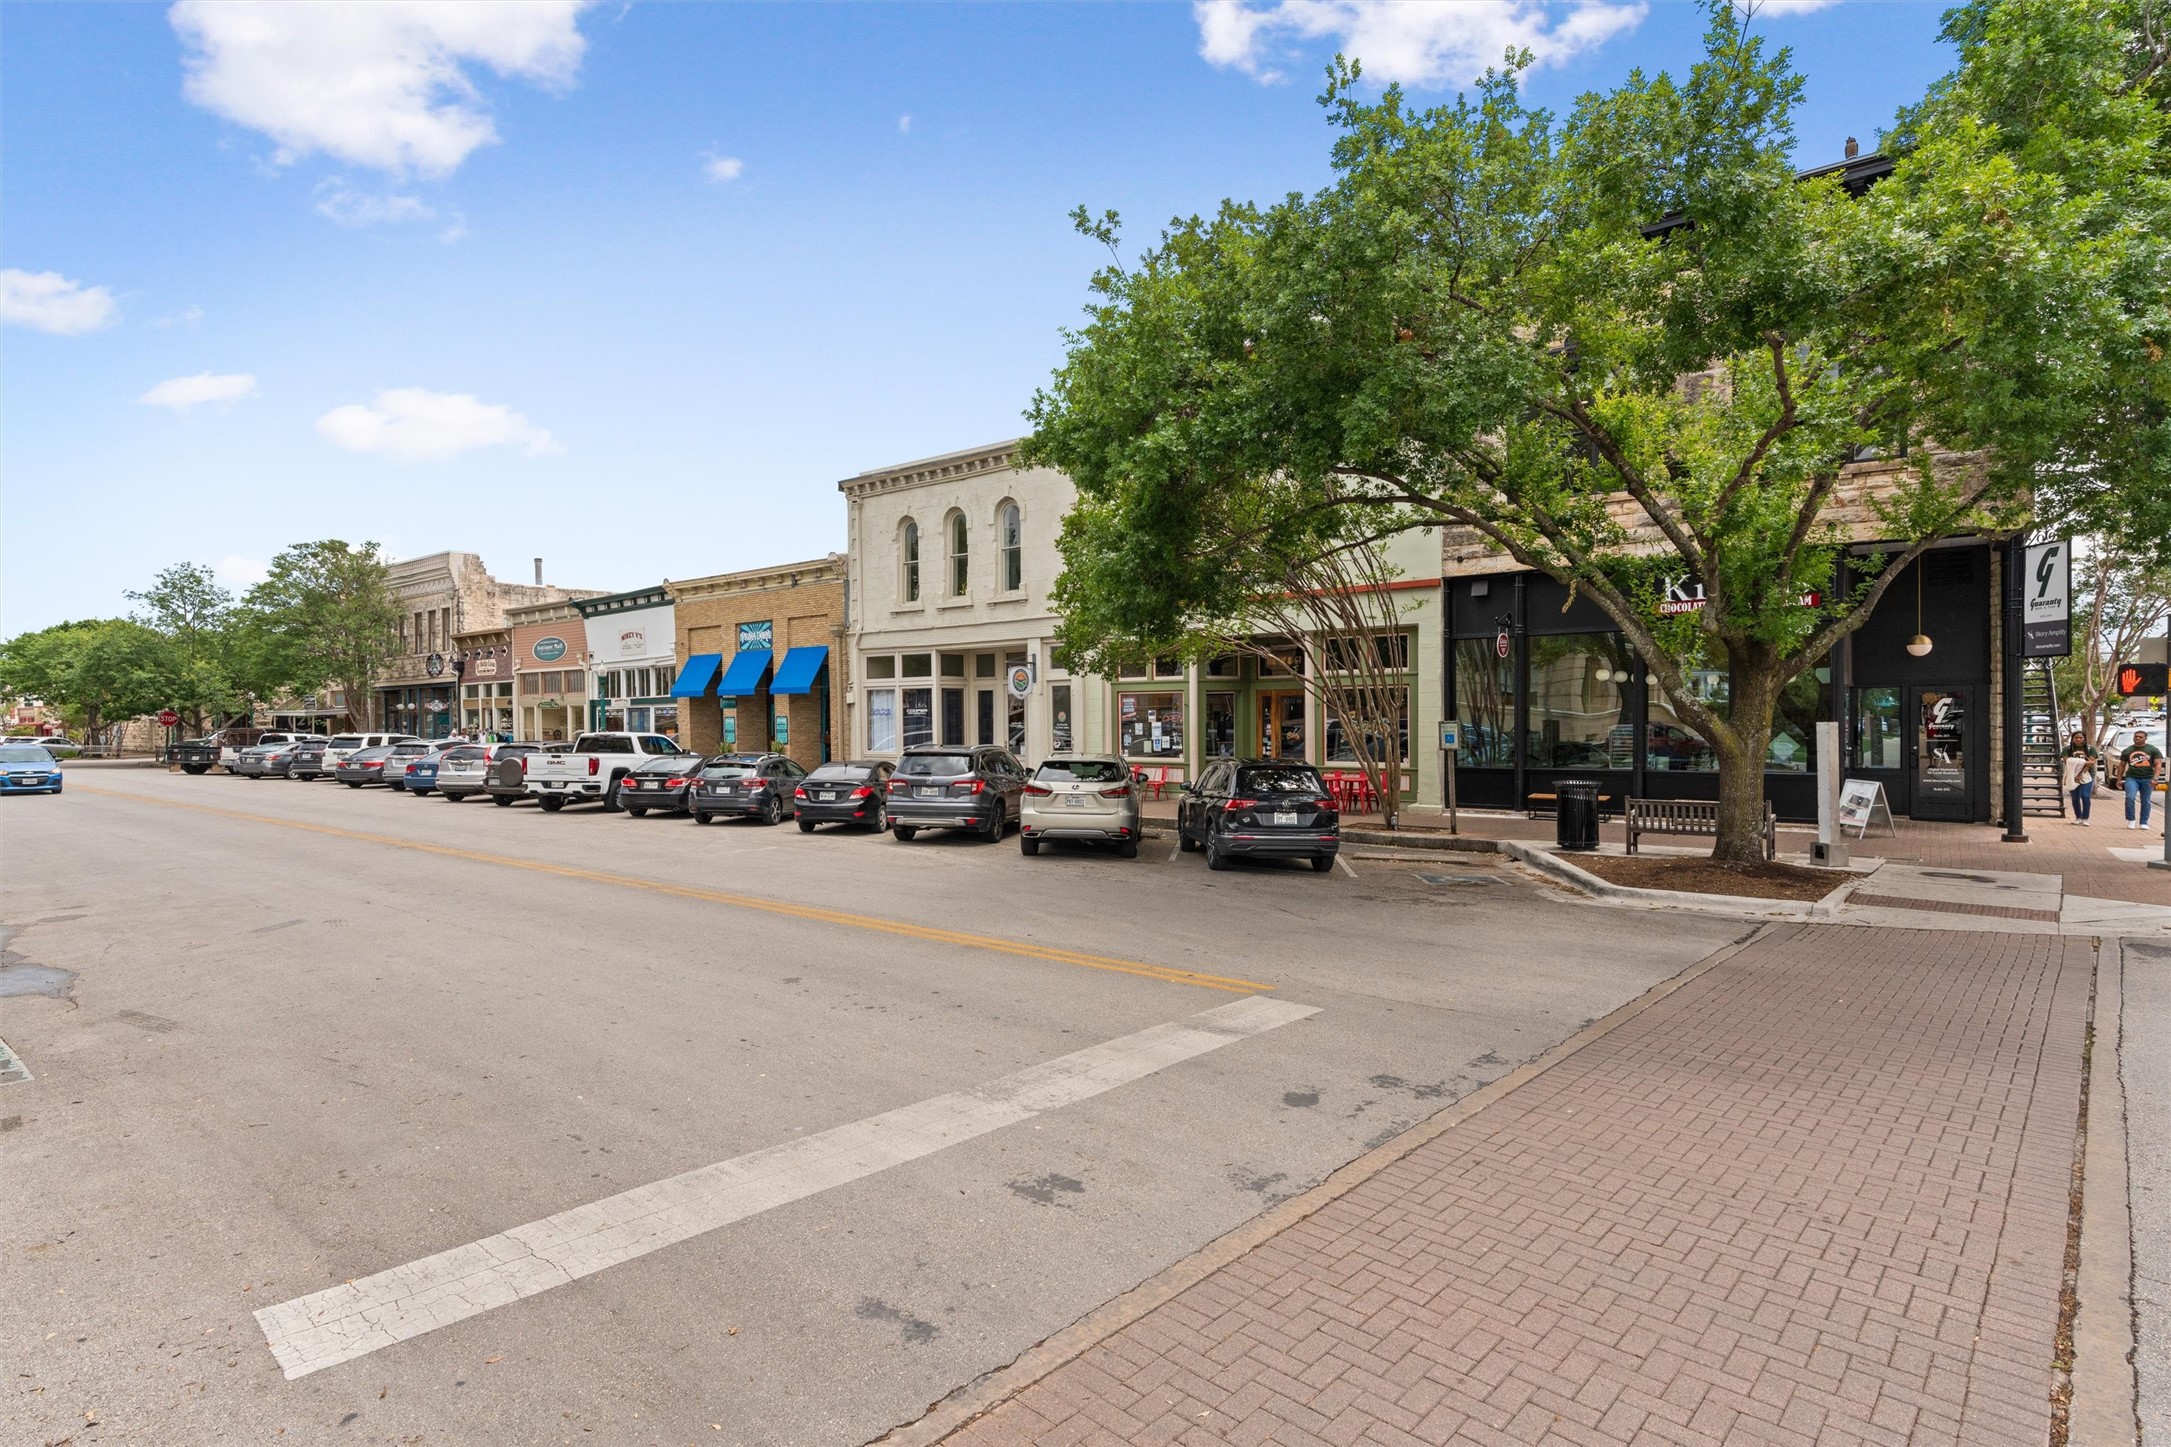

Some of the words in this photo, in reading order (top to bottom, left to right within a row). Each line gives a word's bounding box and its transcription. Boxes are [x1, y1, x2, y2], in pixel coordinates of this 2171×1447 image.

[2030, 597, 2062, 611] Guaranty
[621, 632, 635, 641] MIKEY
[1163, 713, 1183, 722] OPEN
[1928, 722, 1955, 730] Guaranty
